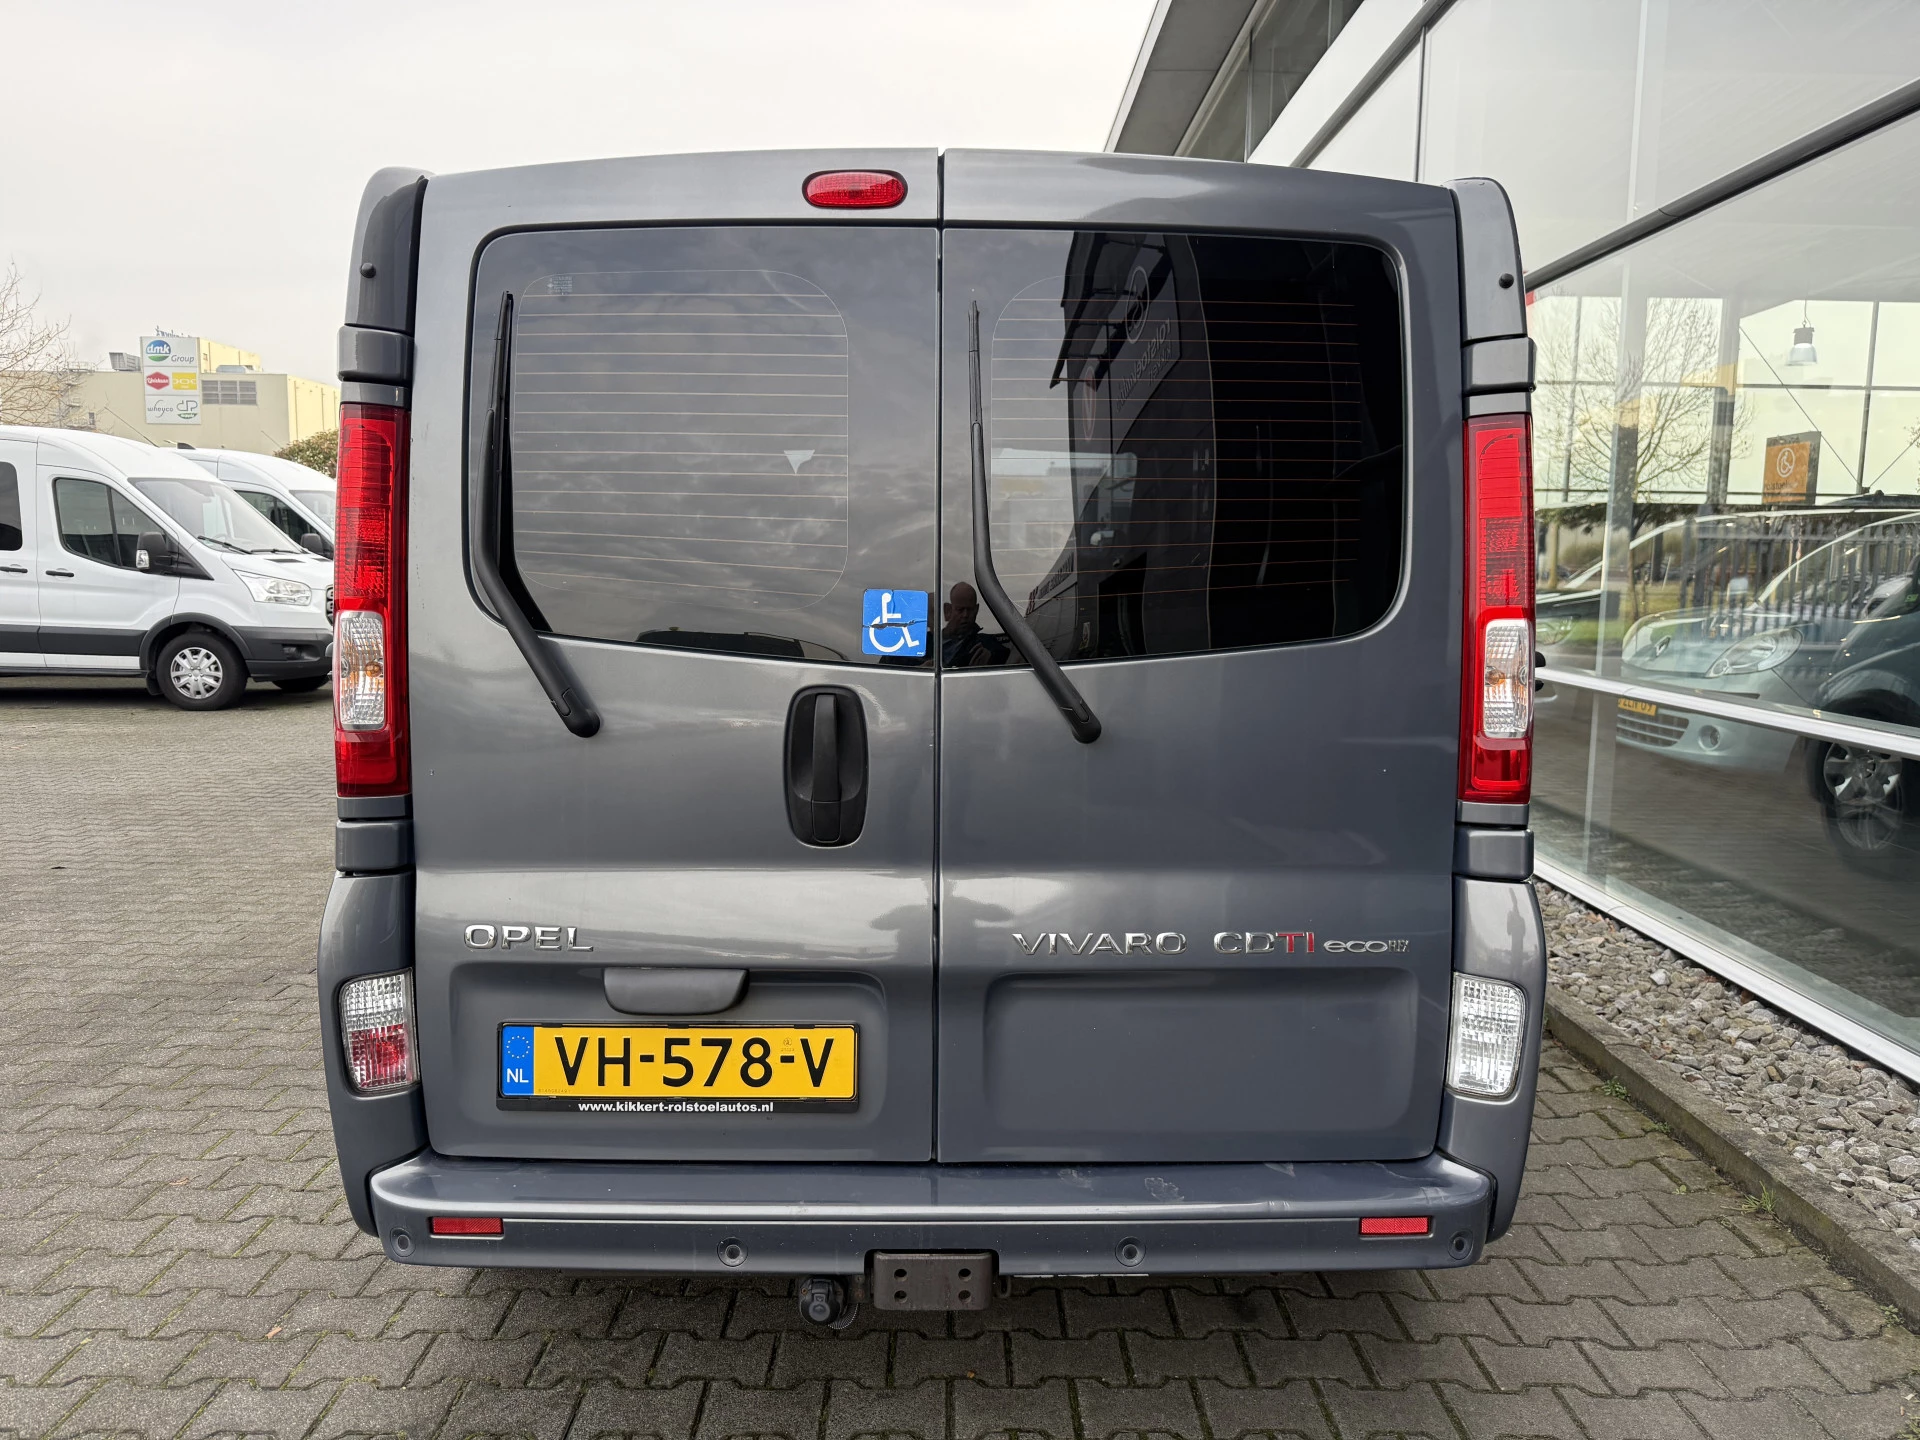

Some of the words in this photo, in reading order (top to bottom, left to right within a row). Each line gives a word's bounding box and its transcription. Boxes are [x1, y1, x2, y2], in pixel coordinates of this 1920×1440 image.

[146, 344, 170, 354] dmk
[171, 355, 195, 364] Group
[147, 400, 174, 418] wheyco
[463, 923, 595, 952] OPEL
[1011, 931, 1188, 956] VIVARO
[1213, 931, 1316, 954] CDTI
[506, 1068, 530, 1084] NL
[553, 1036, 835, 1088] VH-578-V
[578, 1101, 775, 1113] www.kikkert-rolstoelautos.nl
